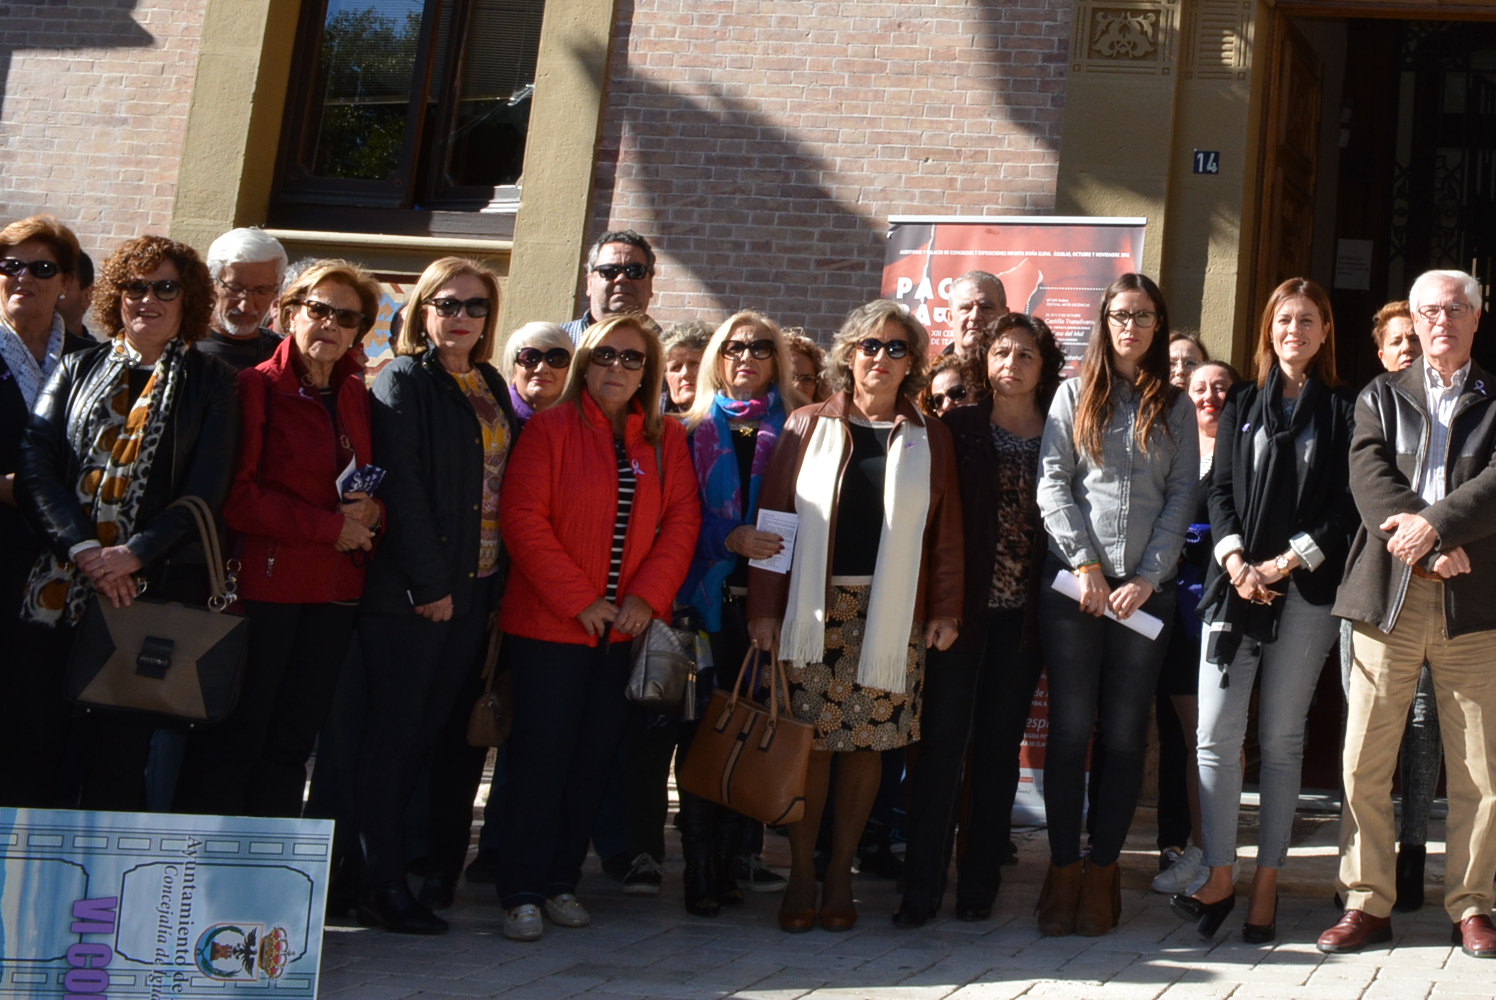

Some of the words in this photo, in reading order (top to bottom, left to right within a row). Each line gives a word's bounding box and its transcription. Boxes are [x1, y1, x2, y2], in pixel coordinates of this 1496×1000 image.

[1197, 152, 1218, 173] 14
[155, 864, 178, 944] Concejalía
[174, 836, 203, 966] Ayuntamiento
[63, 896, 118, 1000] VICO
[154, 947, 170, 966] de
[172, 971, 189, 994] de
